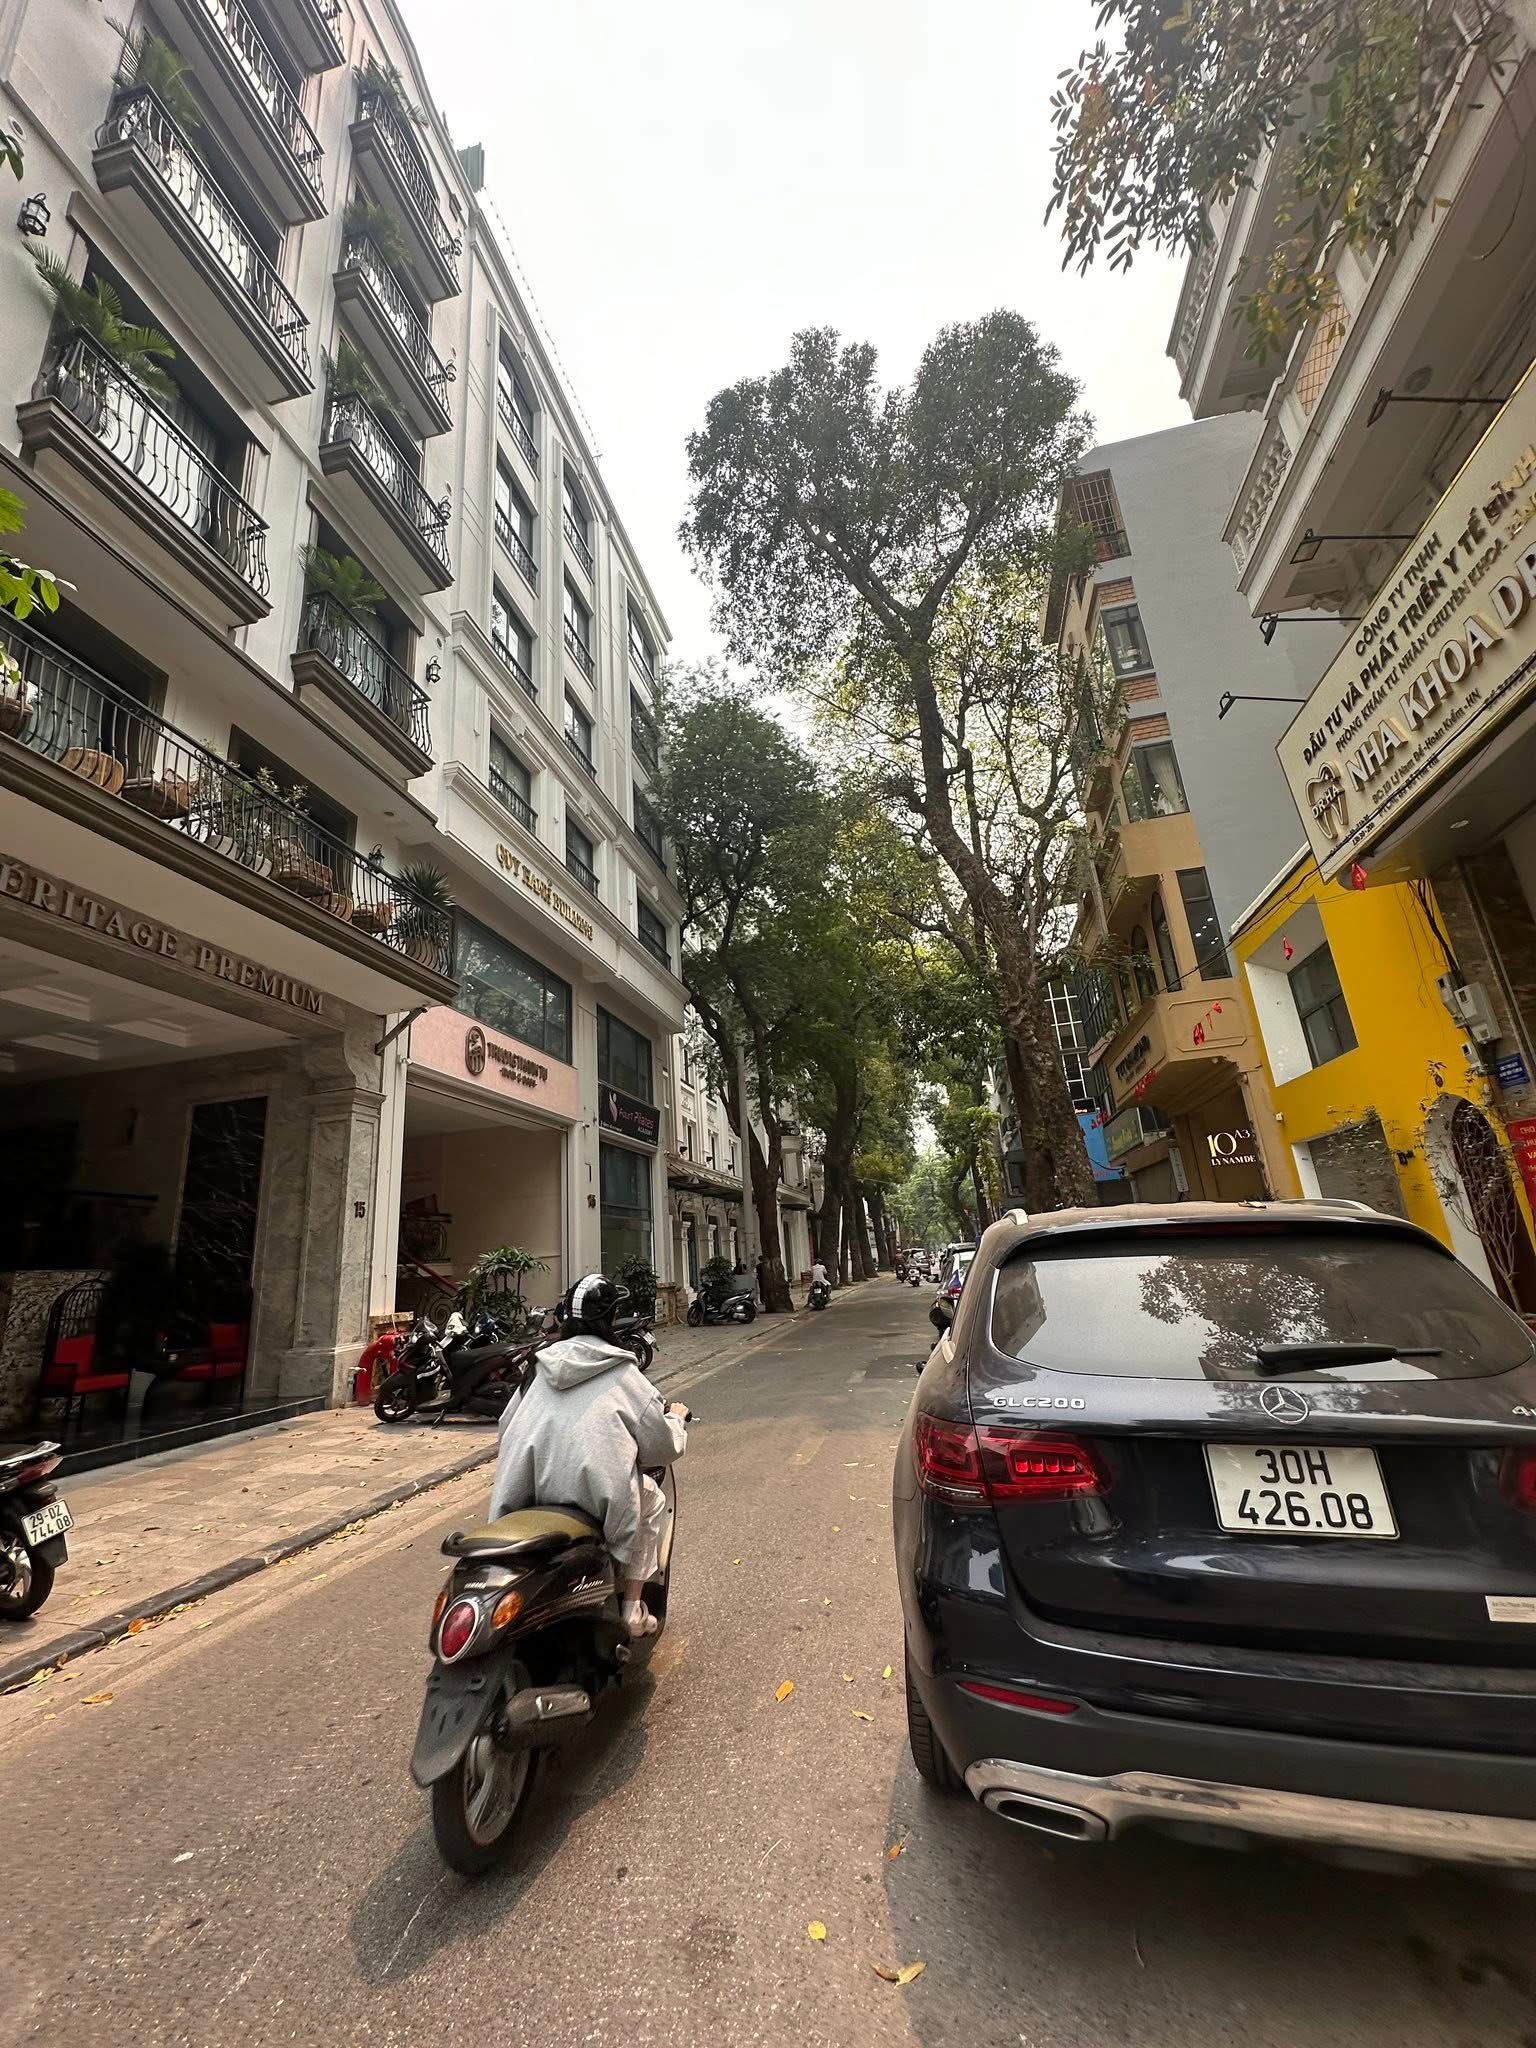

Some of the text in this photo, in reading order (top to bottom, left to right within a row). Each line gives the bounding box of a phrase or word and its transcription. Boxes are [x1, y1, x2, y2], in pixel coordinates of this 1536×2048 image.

[1341, 681, 1364, 713] VÀ
[1360, 629, 1400, 690] PHÁT
[1398, 567, 1448, 637] TRIỂN
[1443, 546, 1460, 575] Y
[1458, 506, 1487, 556] TẾ
[1355, 531, 1442, 656] CÔNG TY TNHH
[1345, 719, 1405, 792] NHA
[1399, 614, 1501, 731] KHOA
[1335, 716, 1363, 752] PHÒNG
[195, 945, 323, 1014] PREMIUM
[354, 1201, 366, 1219] 15
[992, 1396, 1085, 1409] GLC200
[1255, 1449, 1332, 1485] 30H
[29, 1504, 63, 1528] 29-D2
[1238, 1489, 1373, 1529] 426.08
[30, 1515, 71, 1542] 744.08
